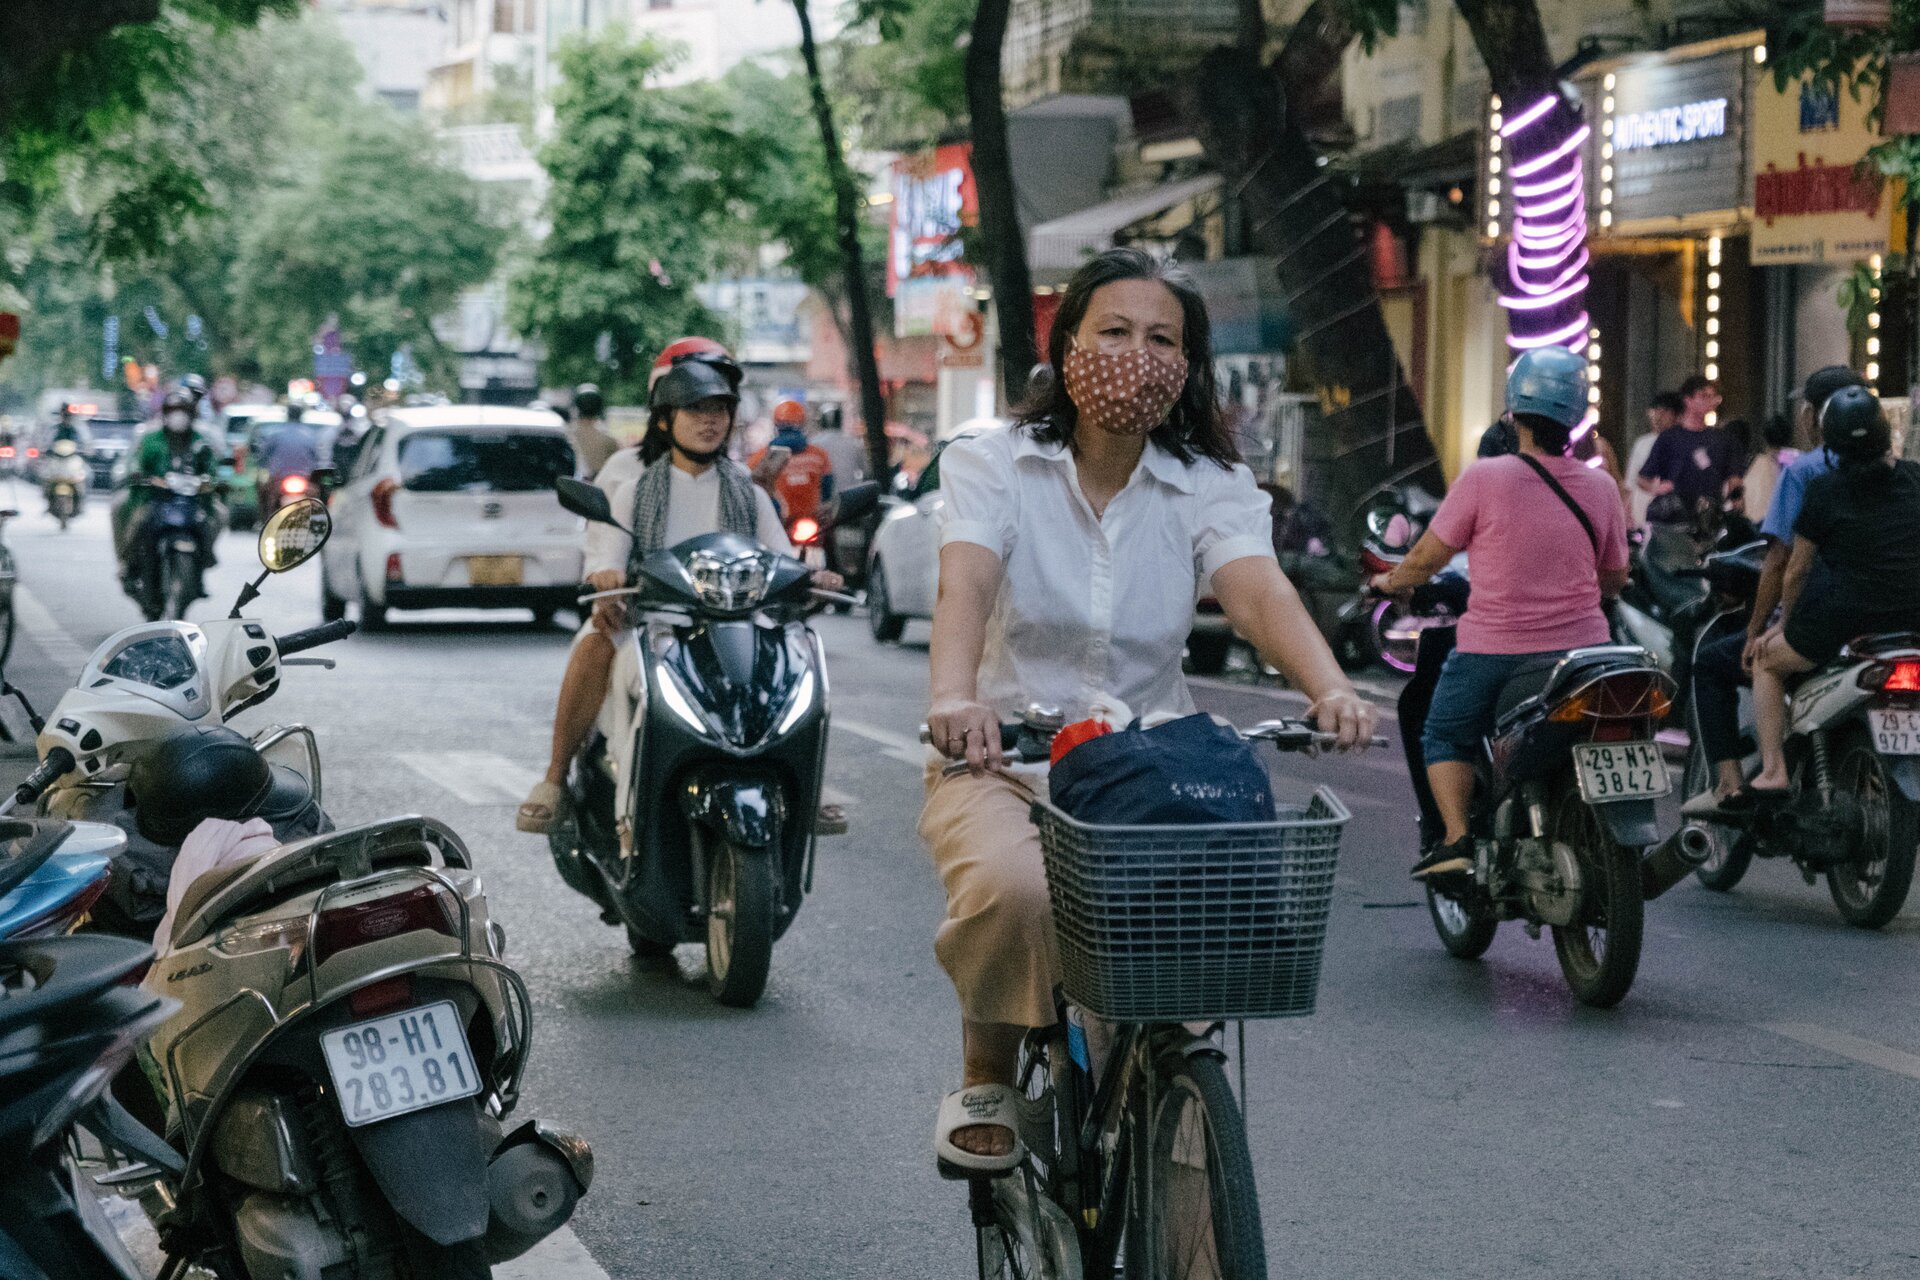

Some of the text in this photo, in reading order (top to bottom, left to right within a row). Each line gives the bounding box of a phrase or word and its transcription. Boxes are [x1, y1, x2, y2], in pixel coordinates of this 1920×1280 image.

[1681, 98, 1727, 142] SPORT
[1881, 713, 1920, 731] 29-C
[1595, 769, 1655, 794] 3842
[342, 1011, 443, 1070] 98-H1
[344, 1051, 468, 1117] 283.81
